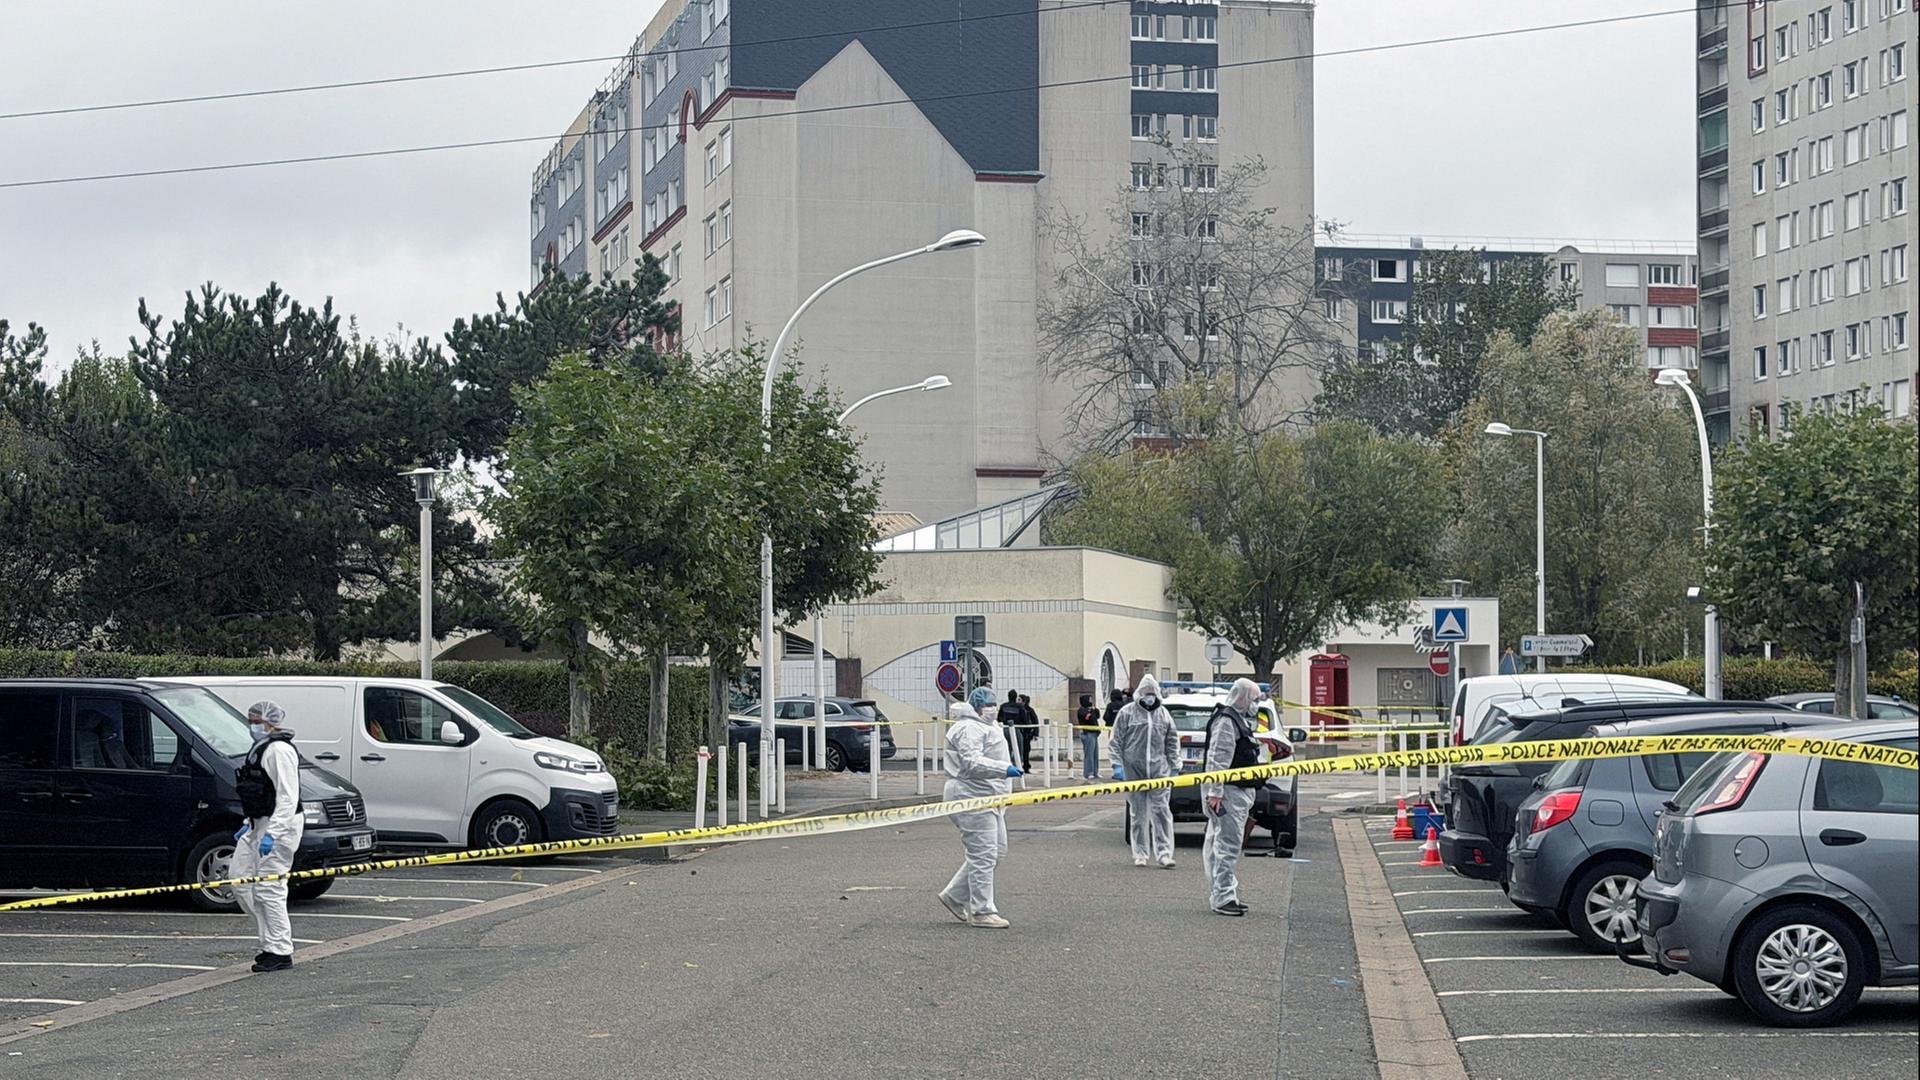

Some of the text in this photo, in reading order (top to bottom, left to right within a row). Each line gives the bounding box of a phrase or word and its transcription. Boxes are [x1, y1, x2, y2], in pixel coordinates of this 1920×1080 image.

[1378, 753, 1406, 769] PAS
[1407, 748, 1484, 768] FRANCHIR
[1501, 743, 1556, 760] POLICE
[1559, 739, 1643, 757] NATIONALE
[1657, 738, 1681, 750] NE
[1680, 738, 1707, 749] PAS
[1709, 738, 1786, 751] FRANCHIR
[1799, 740, 1859, 758] POLICE
